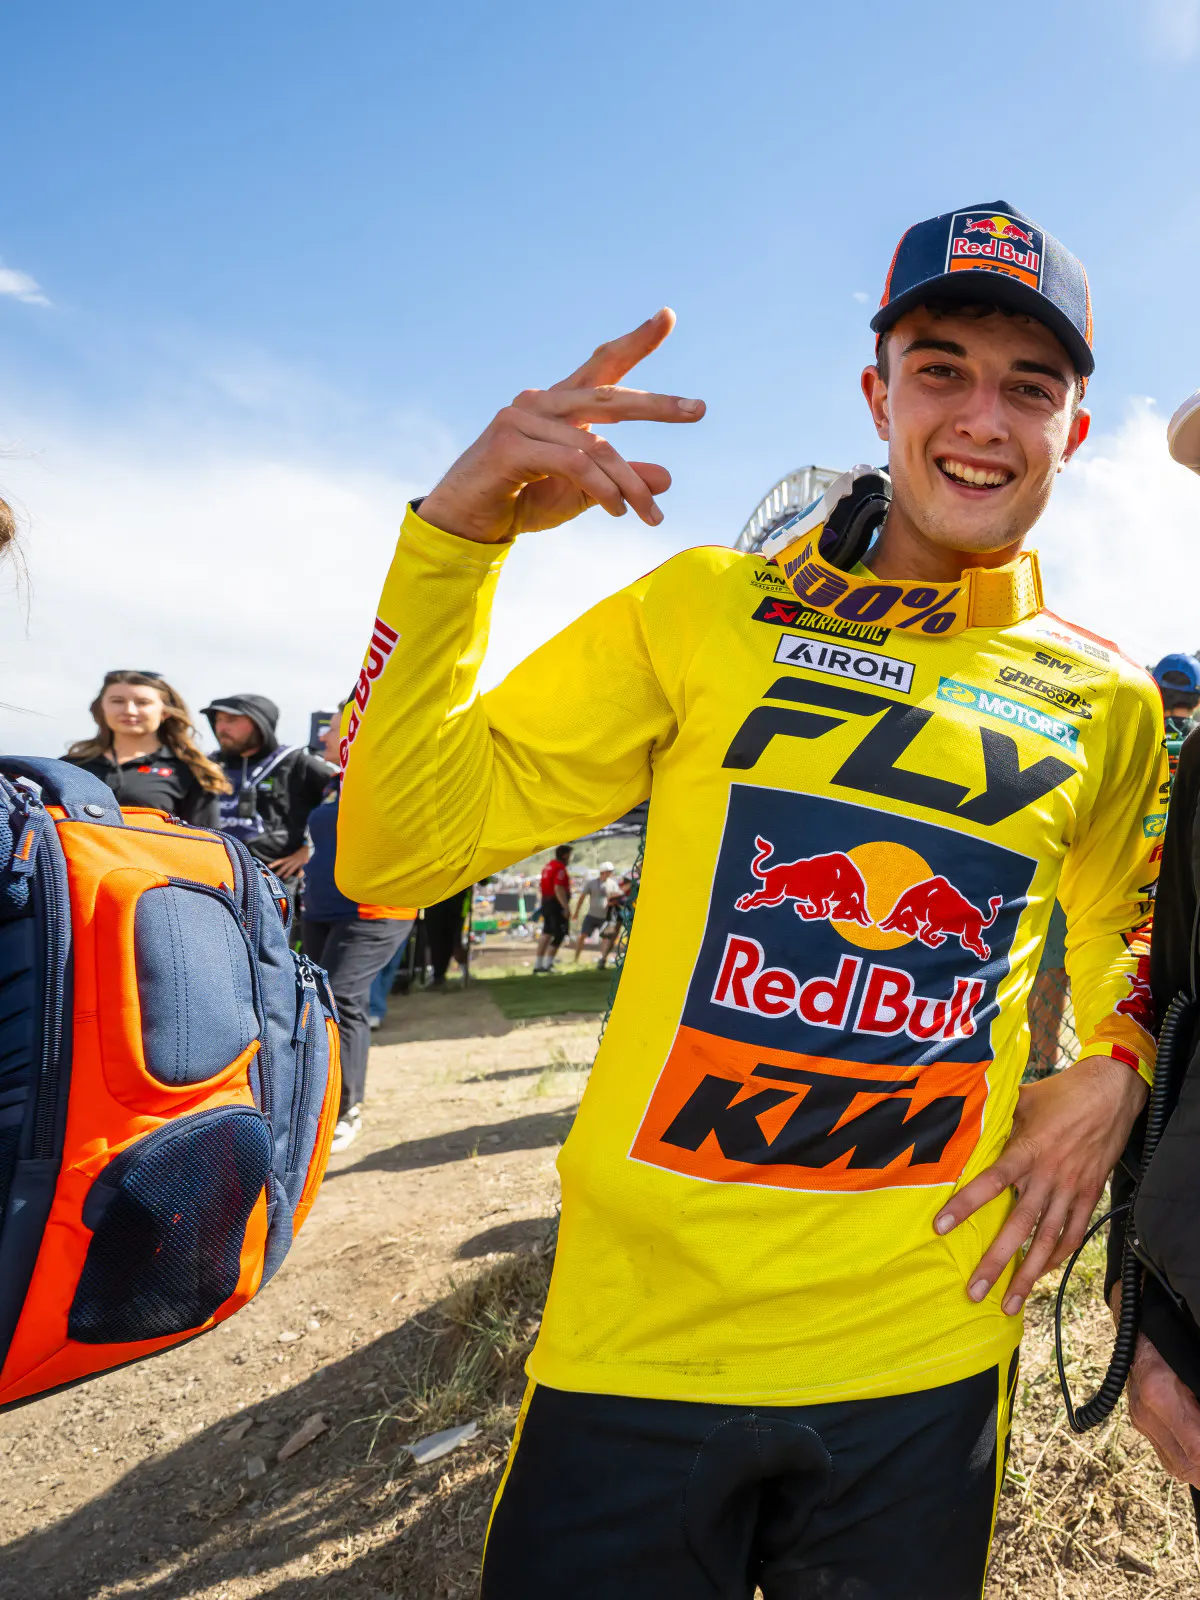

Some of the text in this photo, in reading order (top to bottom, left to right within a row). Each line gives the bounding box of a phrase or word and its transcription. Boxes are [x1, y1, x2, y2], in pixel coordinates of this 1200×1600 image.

[952, 238, 998, 257] Red
[998, 241, 1040, 273] Bull
[786, 642, 905, 687] AIROH
[721, 675, 1078, 826] FLY
[978, 692, 1078, 748] MOTOREX
[710, 933, 988, 1043] Red Bull
[660, 1062, 967, 1170] KTM
